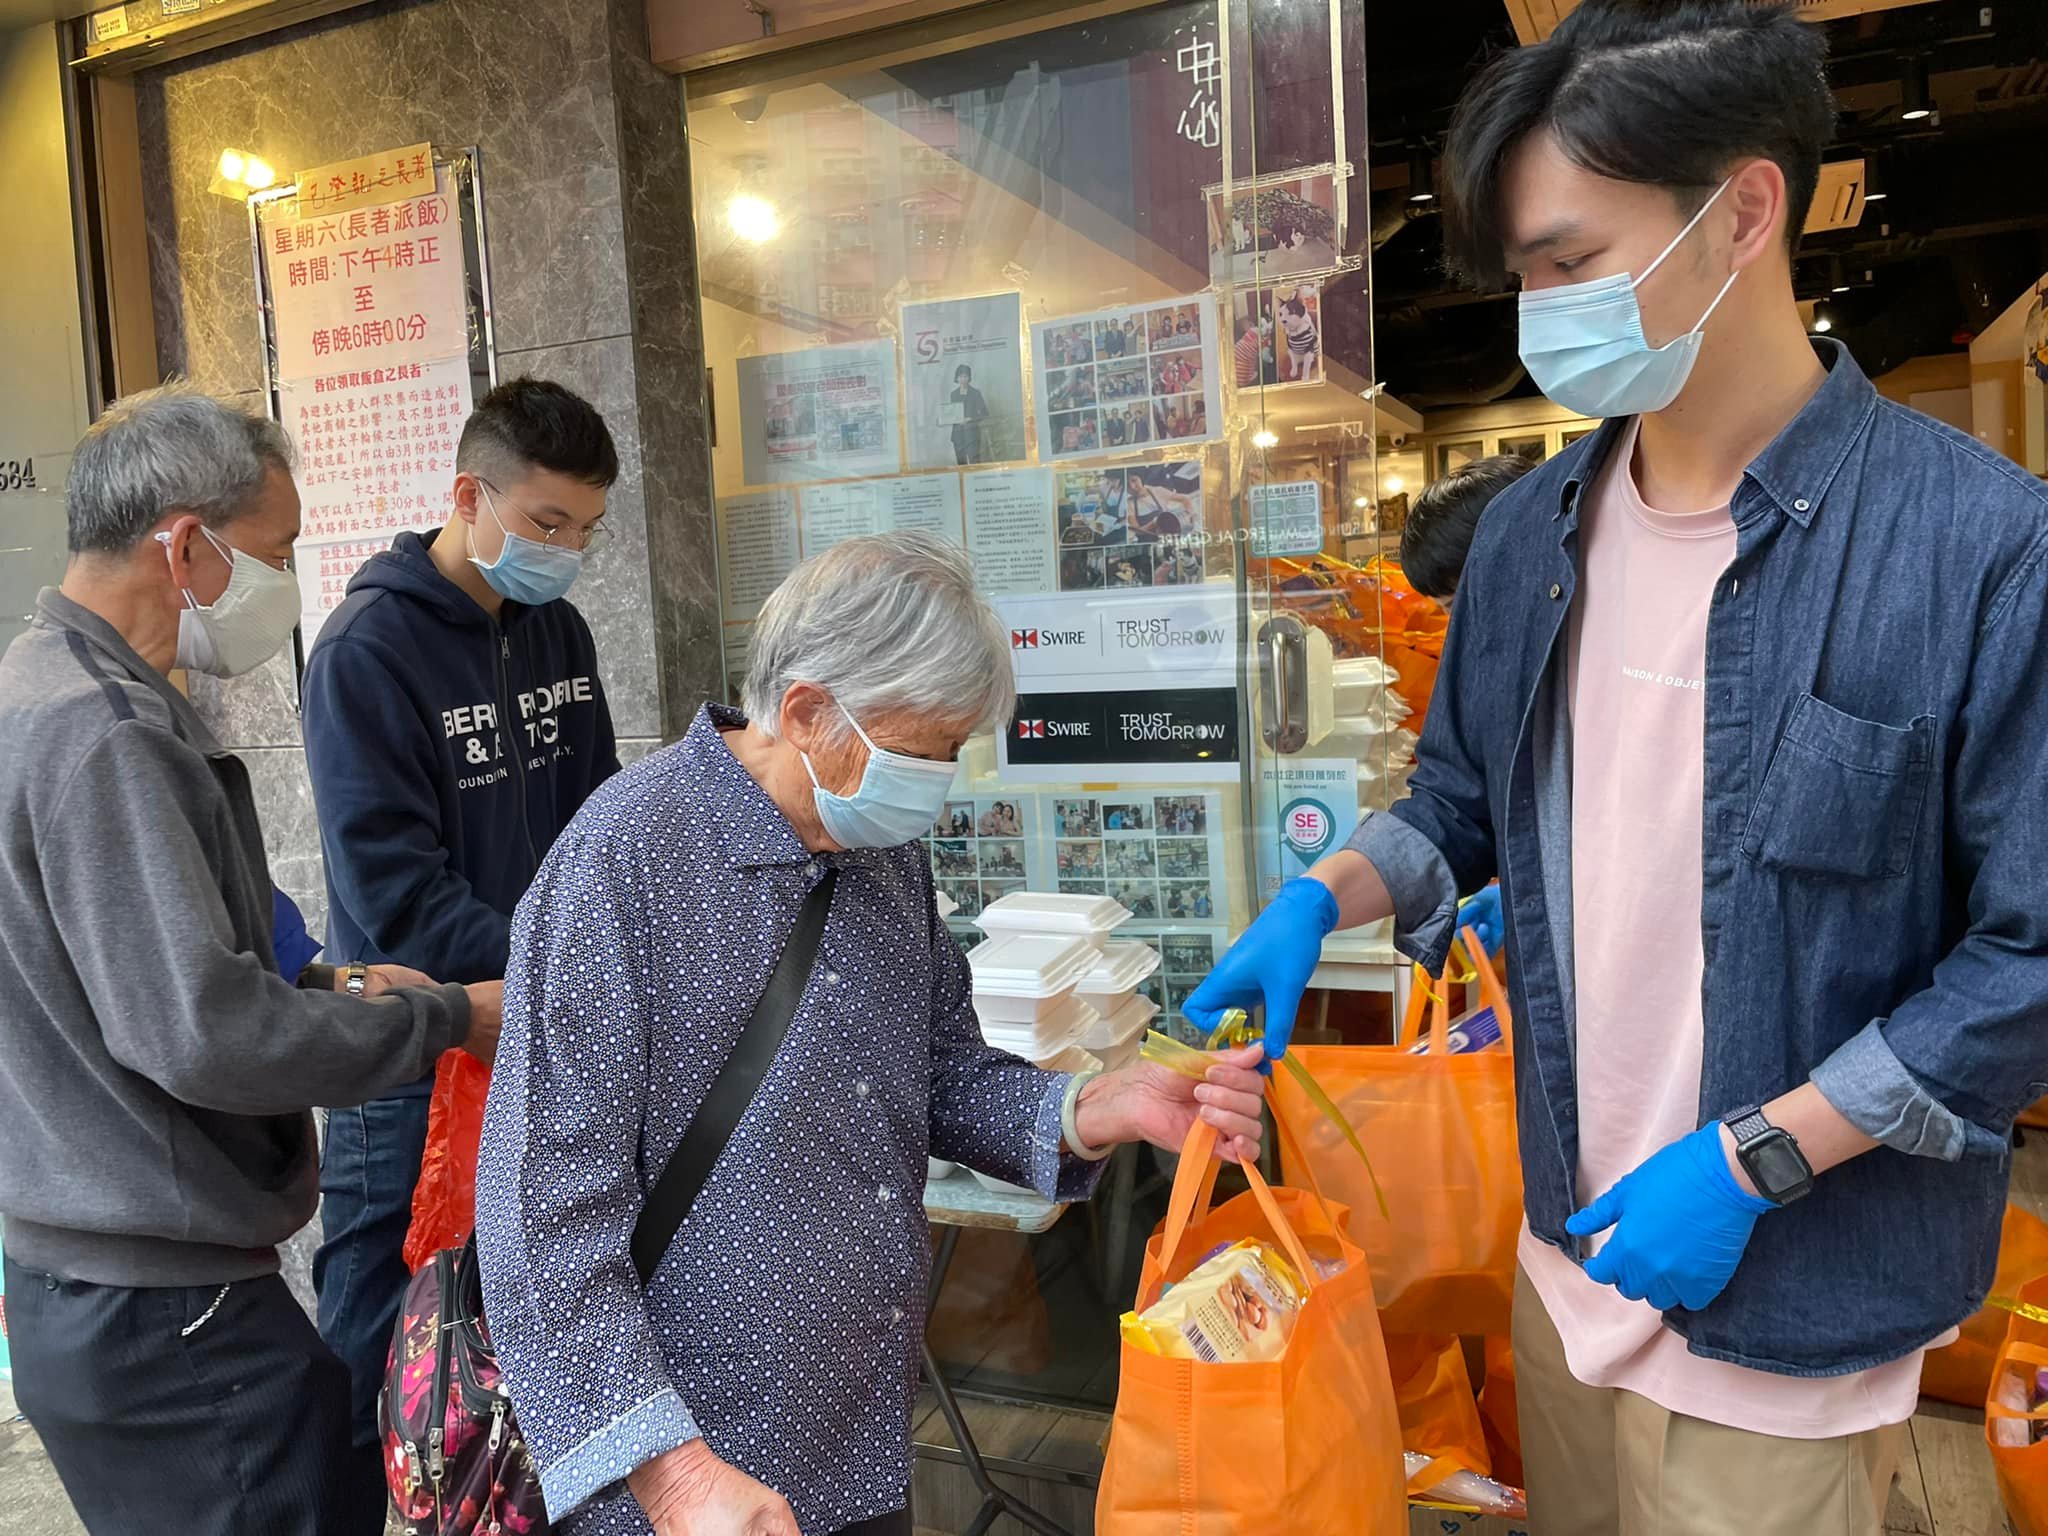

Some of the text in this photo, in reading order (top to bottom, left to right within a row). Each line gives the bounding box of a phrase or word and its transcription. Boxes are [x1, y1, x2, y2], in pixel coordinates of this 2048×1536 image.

[353, 285, 375, 312] 至
[1116, 618, 1171, 633] TRUST
[1117, 629, 1225, 648] TOMORROW
[1120, 713, 1173, 727] TRUST
[1120, 724, 1225, 741] TOMORROW
[466, 737, 489, 764] &
[1295, 813, 1318, 828] SE
